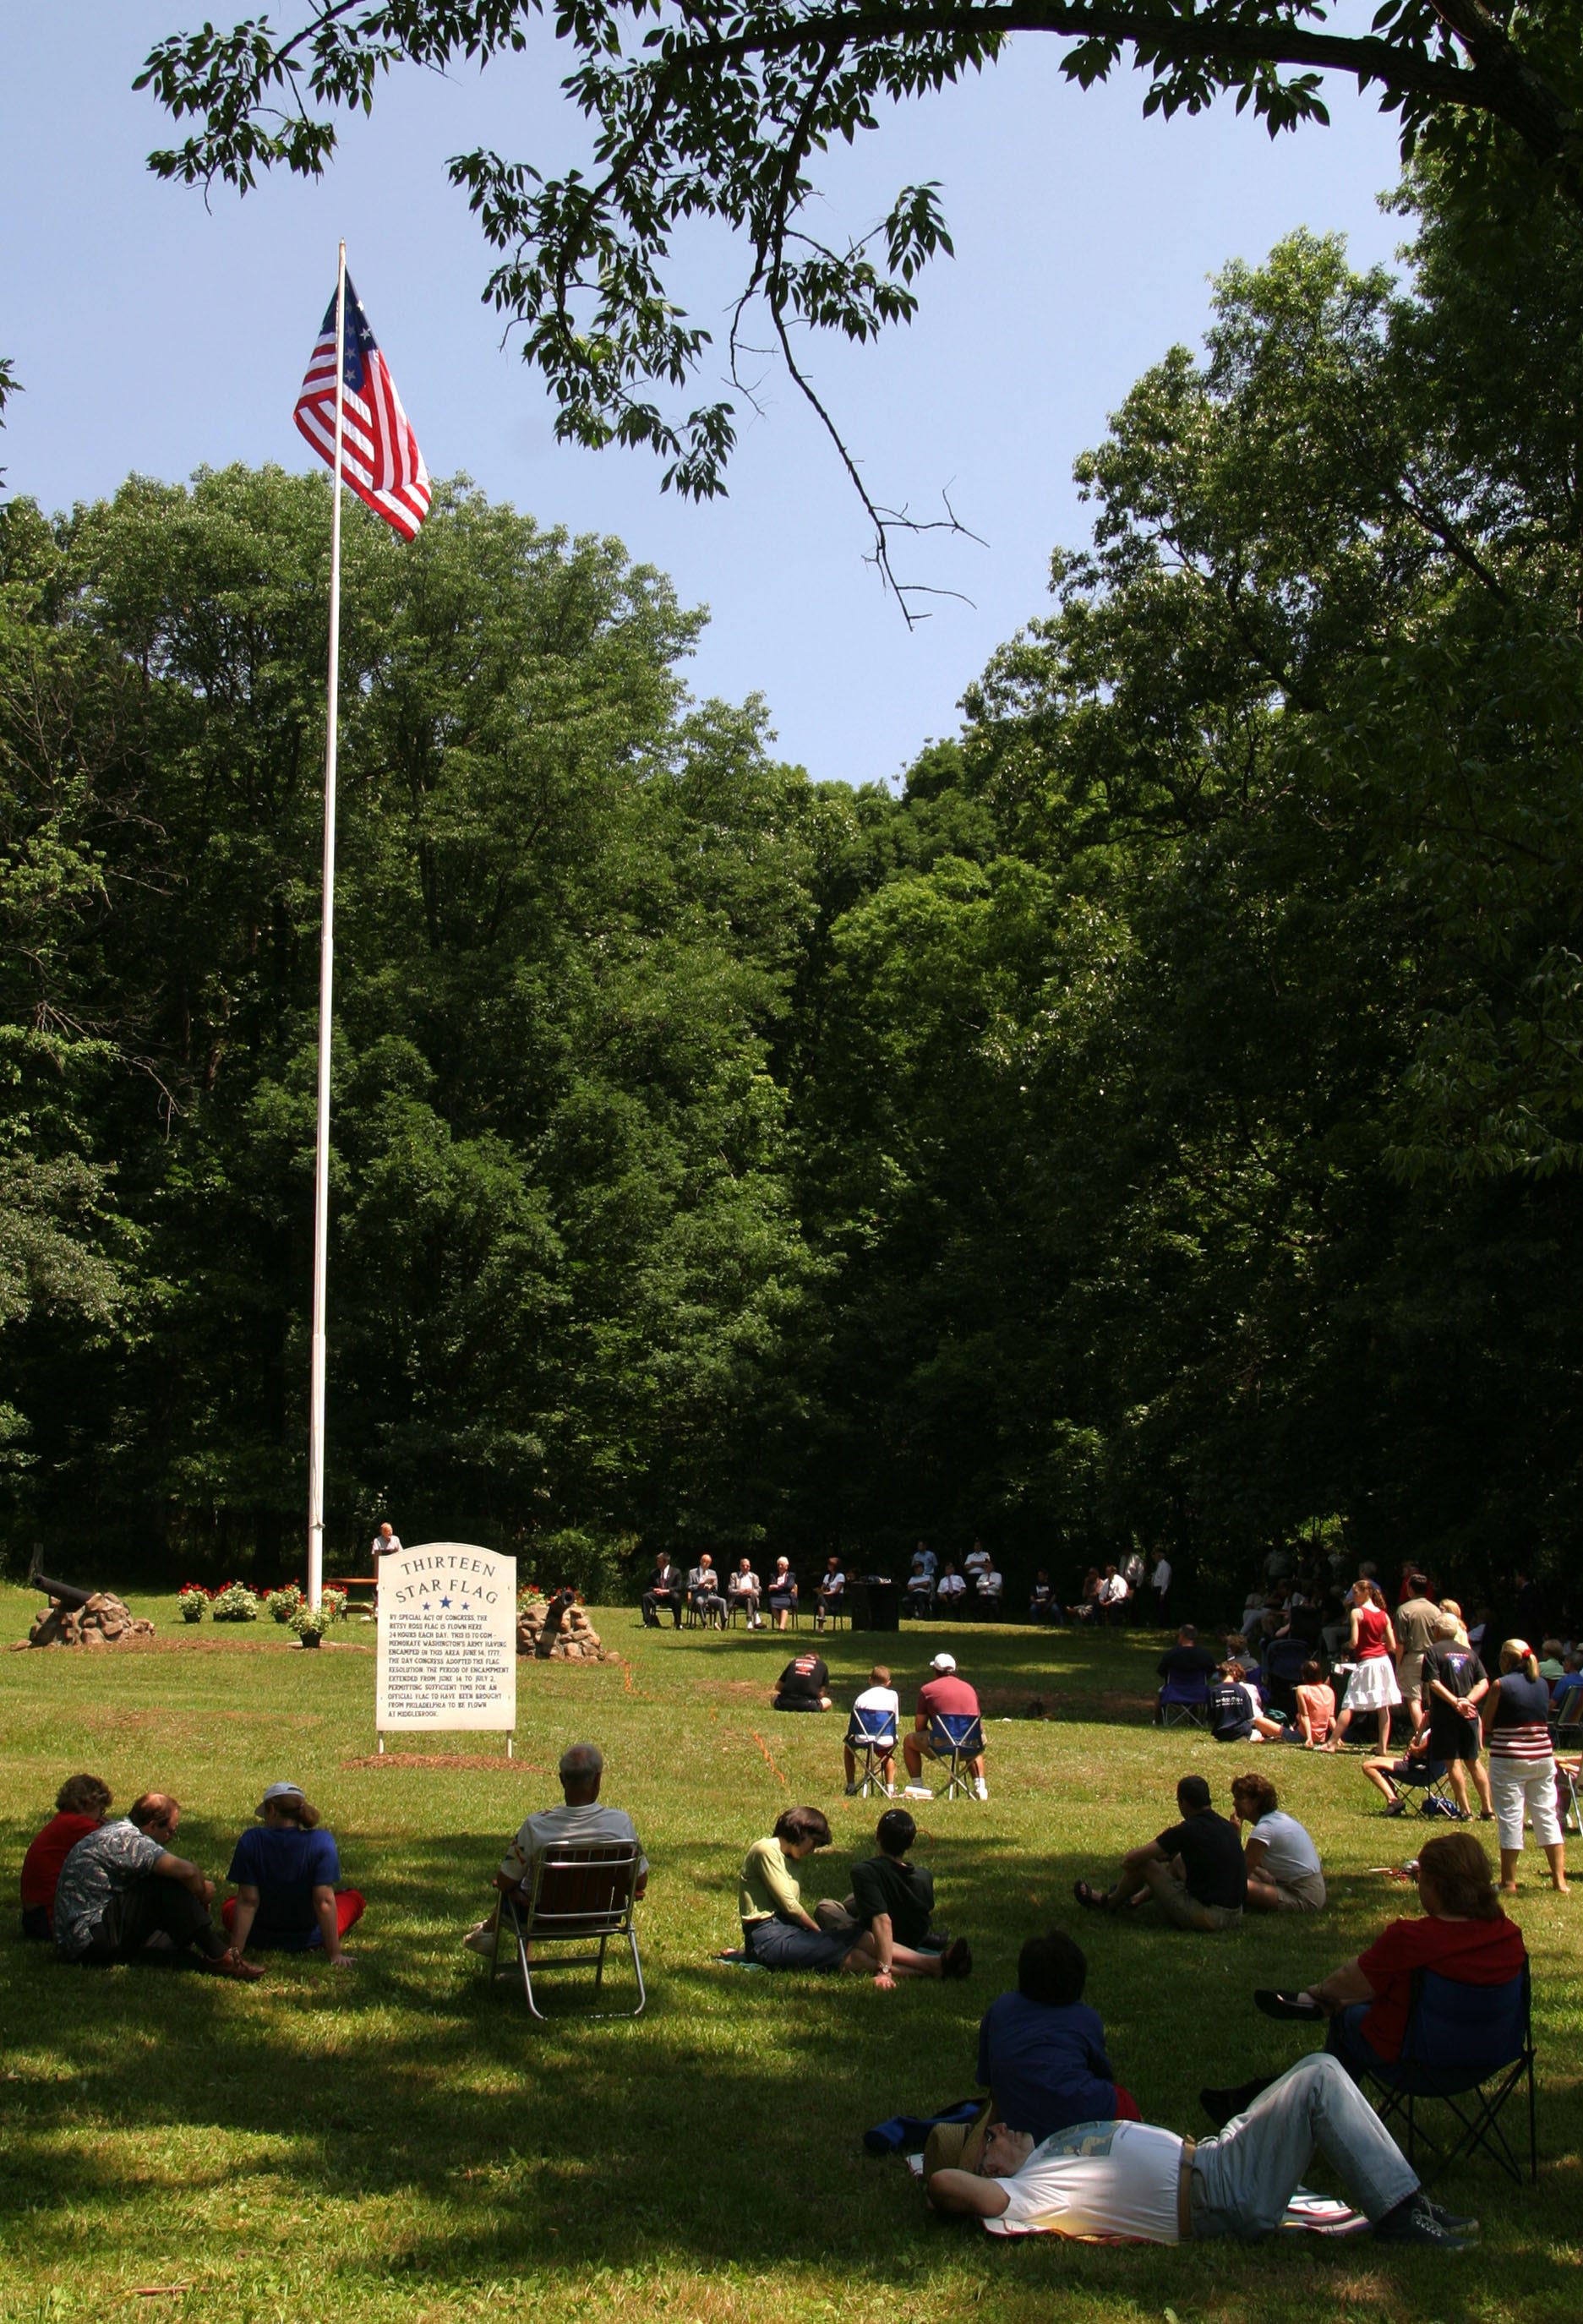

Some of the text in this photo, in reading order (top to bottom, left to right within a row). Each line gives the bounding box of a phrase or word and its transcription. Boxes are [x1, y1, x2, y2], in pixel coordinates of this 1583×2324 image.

[401, 1556, 496, 1577] THIRTEEN
[396, 1579, 499, 1604] STAR FLAG
